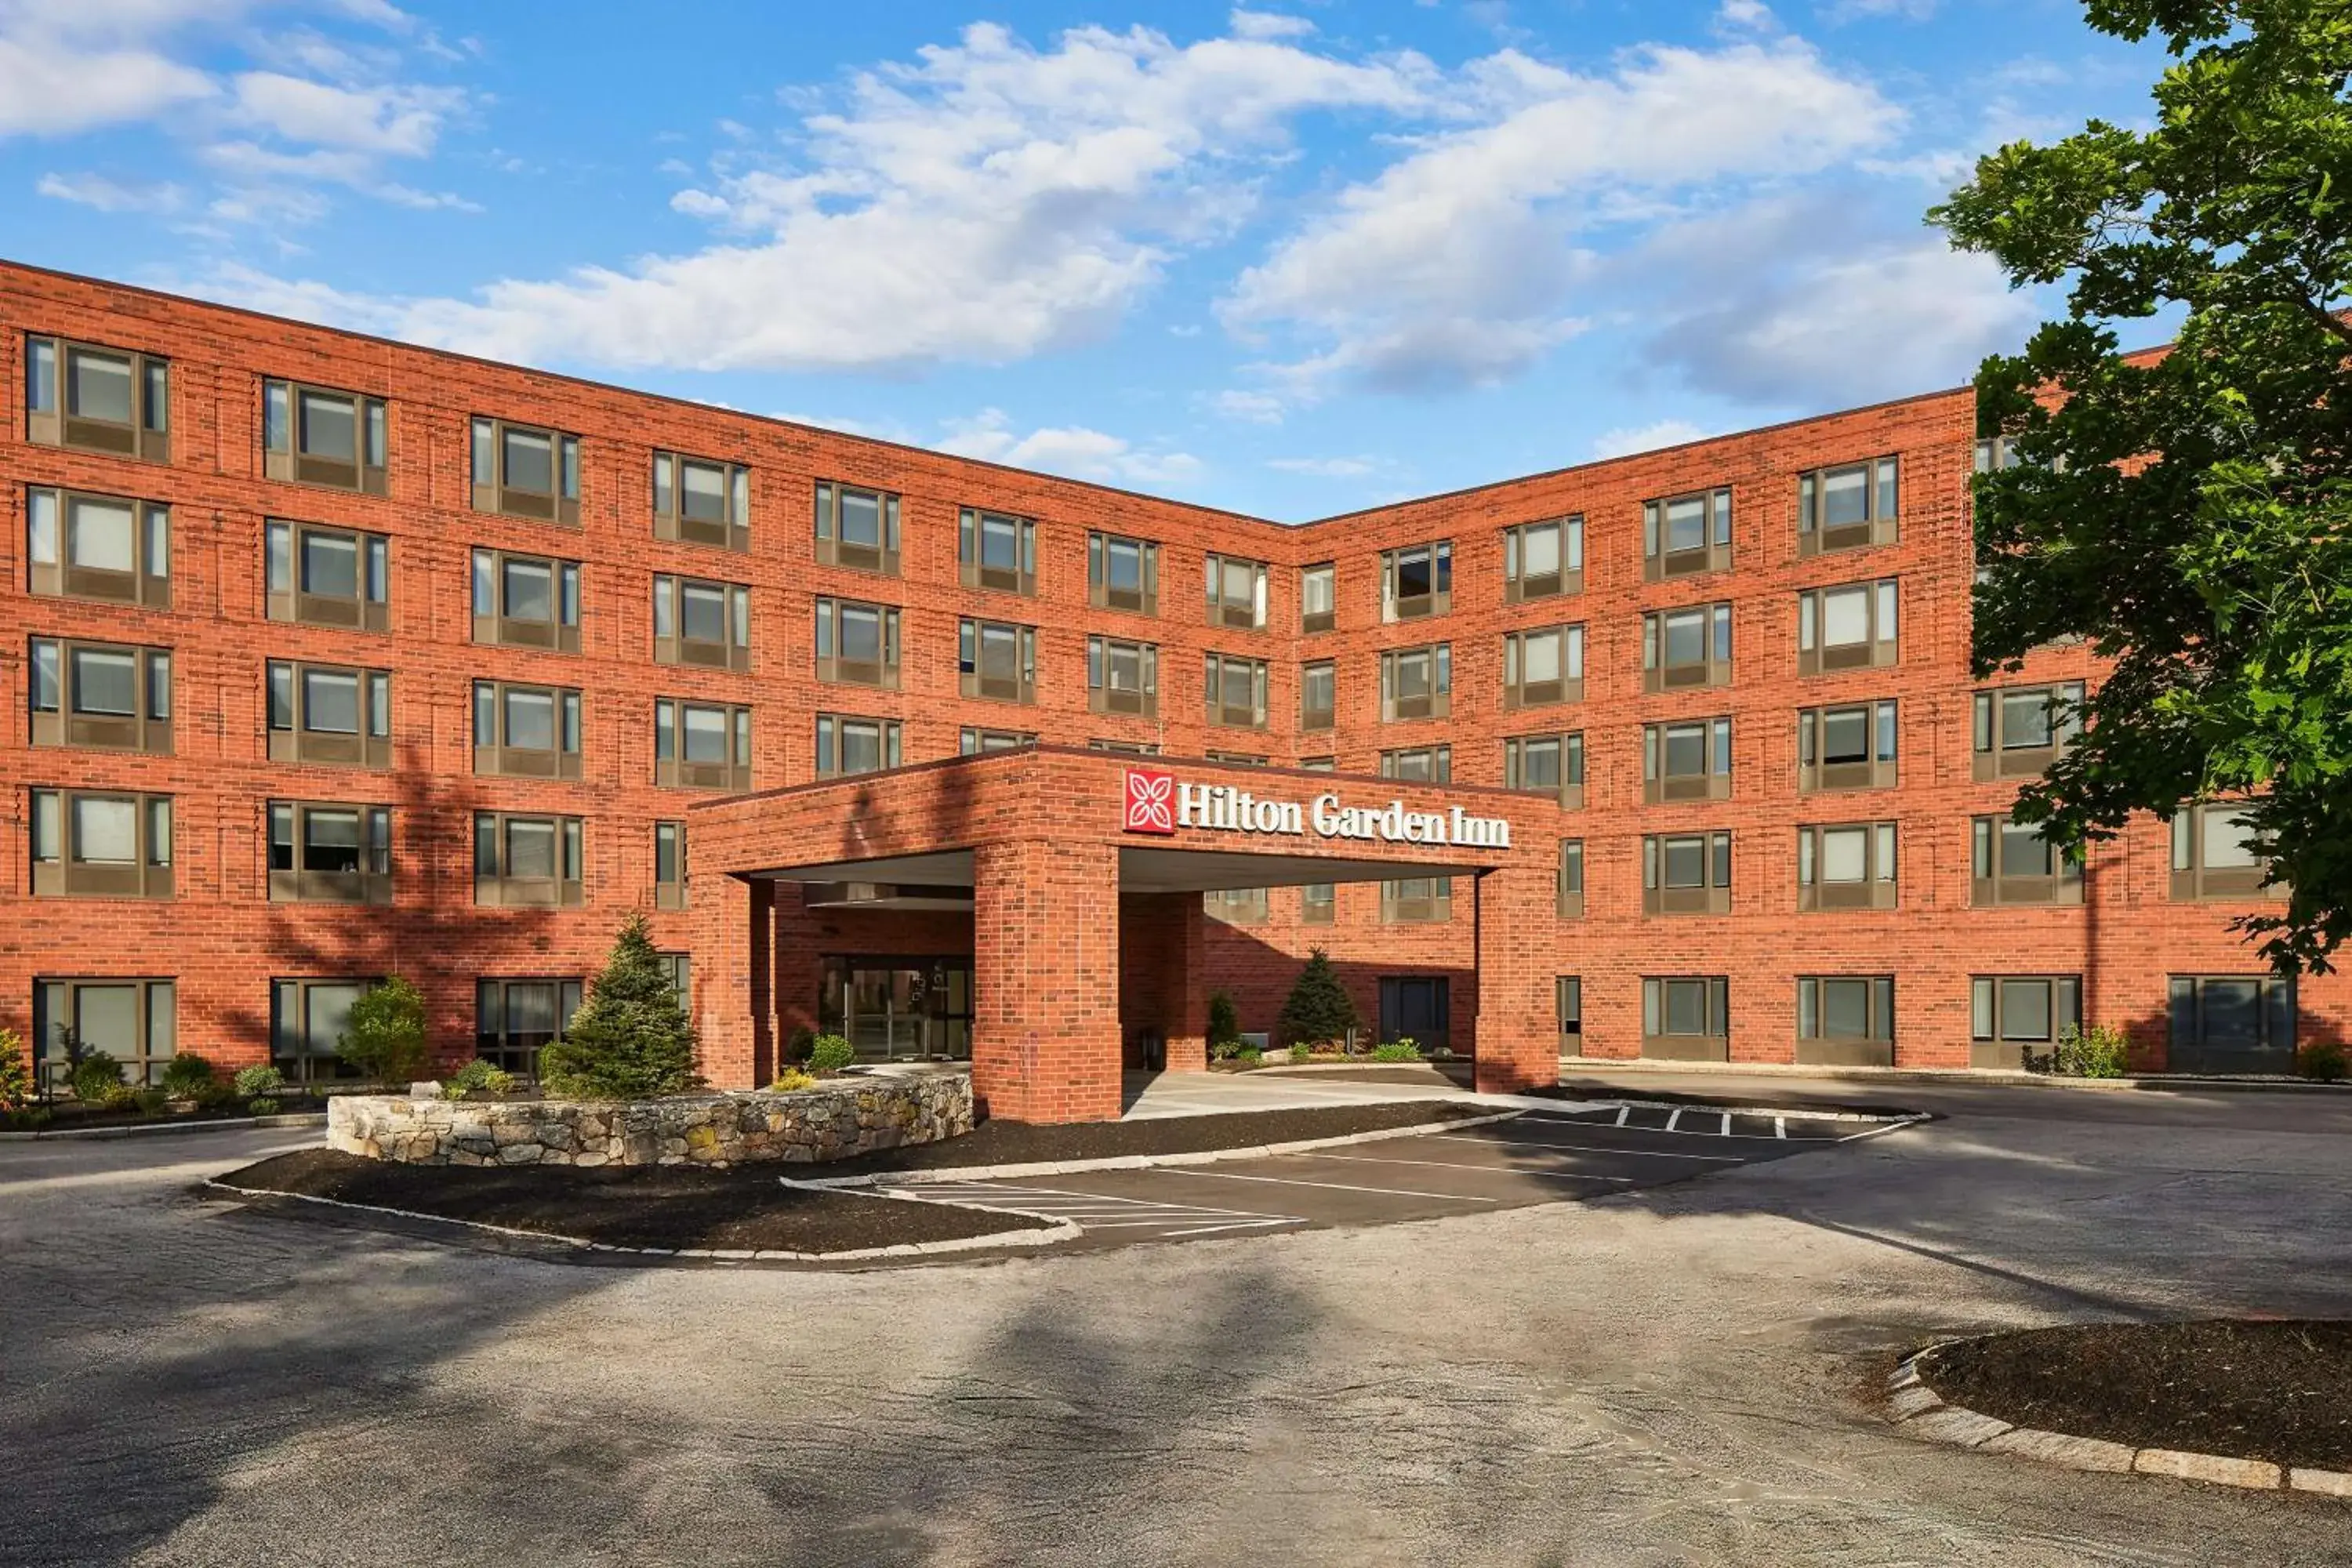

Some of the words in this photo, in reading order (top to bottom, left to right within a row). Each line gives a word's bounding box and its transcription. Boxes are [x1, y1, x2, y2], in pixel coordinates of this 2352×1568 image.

[1178, 784, 1302, 833] Hilton
[1312, 793, 1446, 844] Garden
[1450, 805, 1509, 848] Inn
